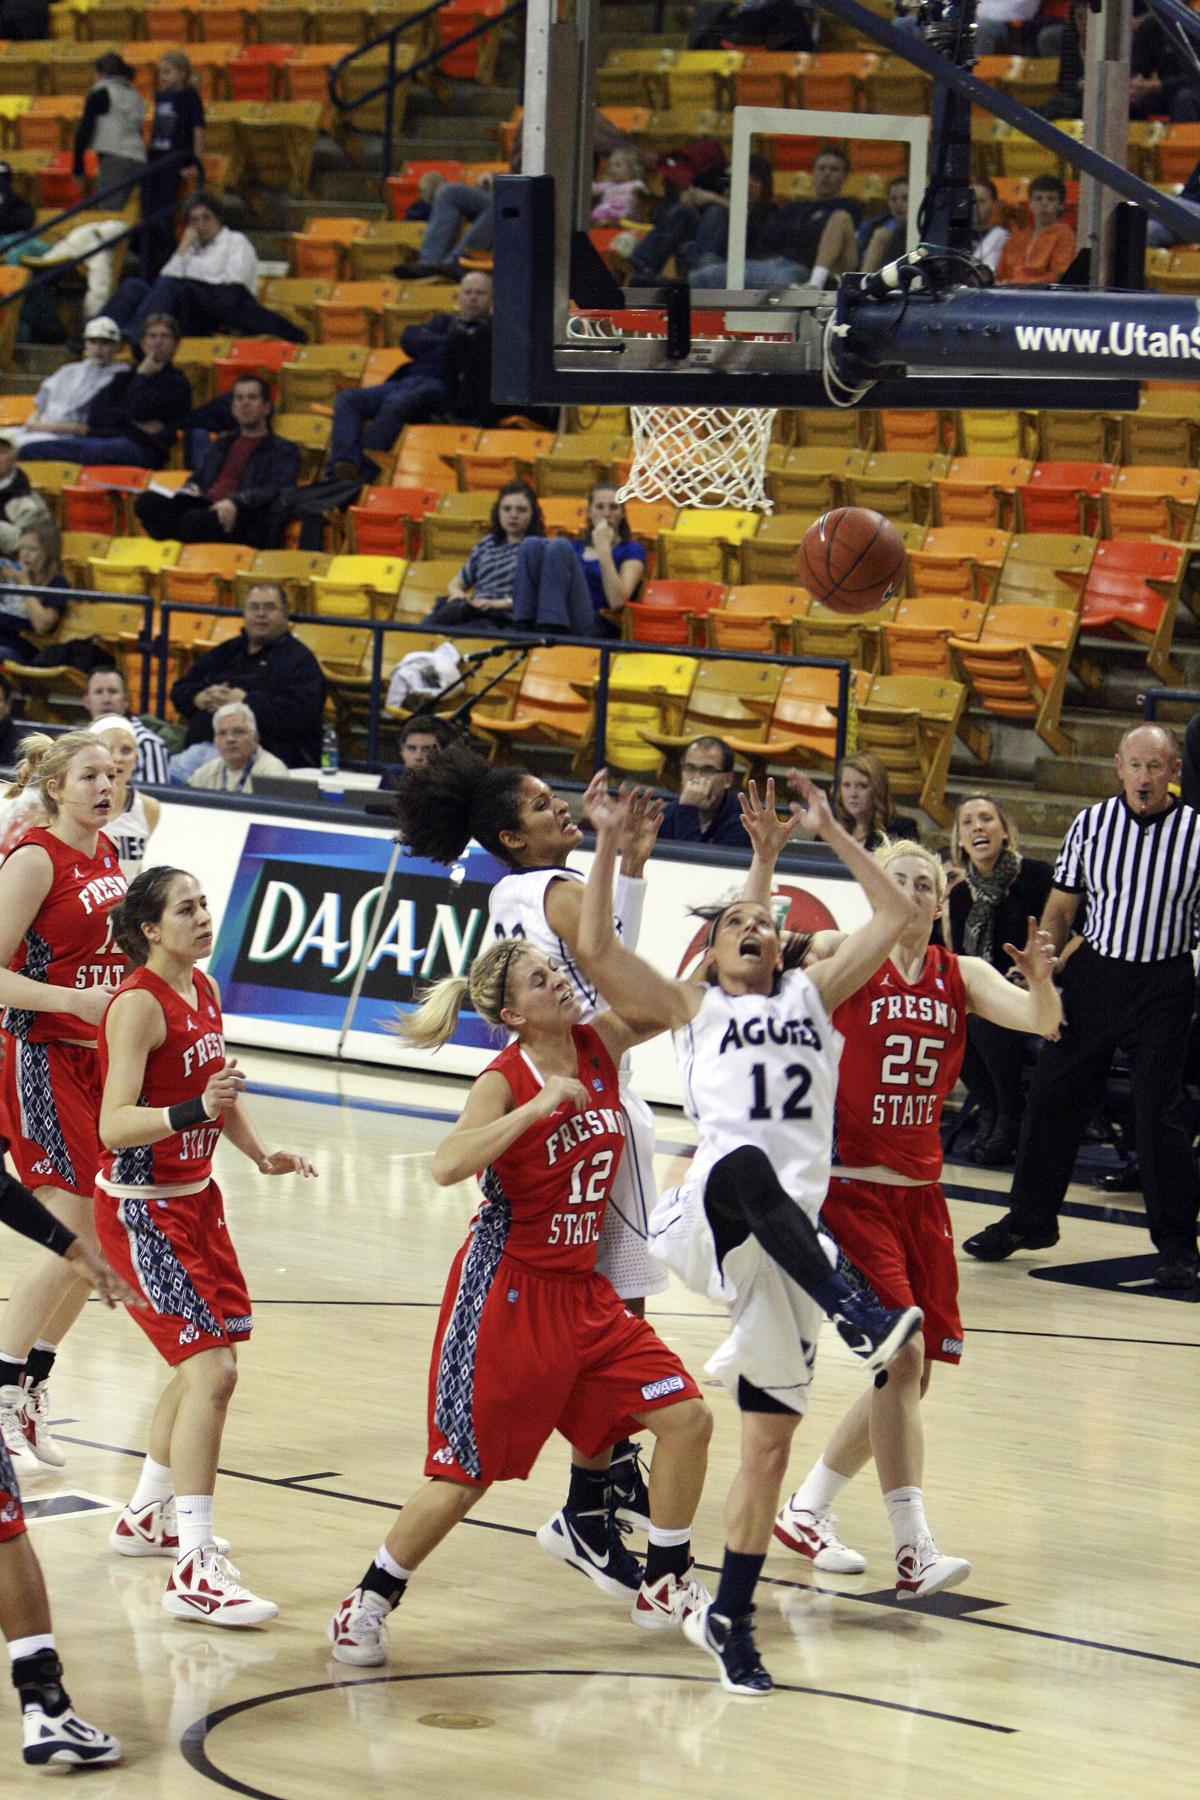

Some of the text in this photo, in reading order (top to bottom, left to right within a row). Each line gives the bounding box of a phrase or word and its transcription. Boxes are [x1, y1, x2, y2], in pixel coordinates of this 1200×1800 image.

[869, 994, 957, 1035] FRESNO
[881, 1033, 945, 1087] 25
[749, 1062, 813, 1121] 12
[871, 1093, 938, 1126] STATE
[567, 1149, 614, 1205] 12
[645, 1378, 680, 1397] WAC
